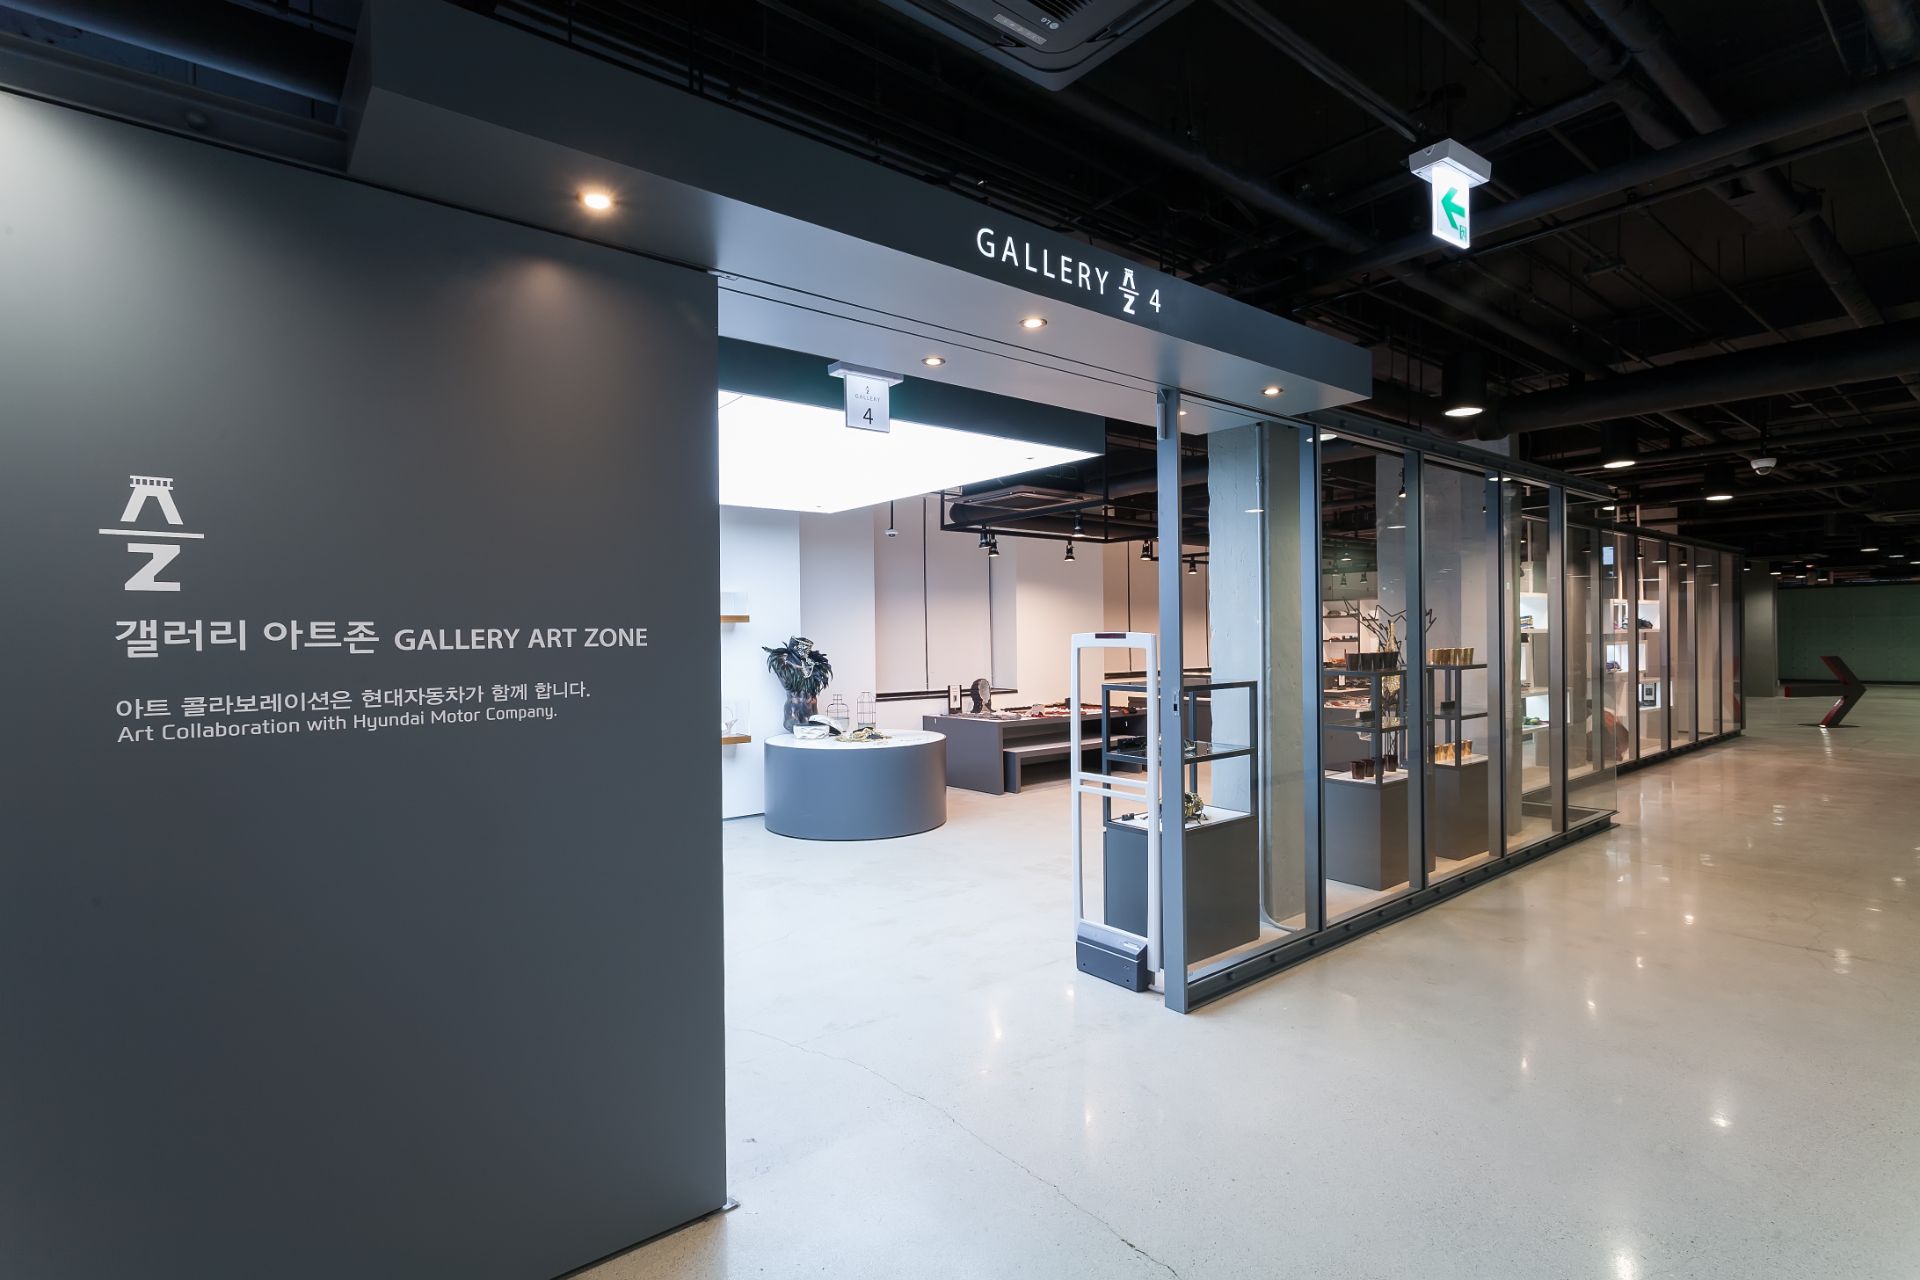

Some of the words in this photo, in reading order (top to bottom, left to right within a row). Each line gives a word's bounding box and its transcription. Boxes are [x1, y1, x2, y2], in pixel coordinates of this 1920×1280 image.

[976, 228, 1109, 295] GALLERY
[1149, 288, 1161, 313] 4
[863, 408, 874, 425] 4
[115, 619, 247, 659] 갤러리
[263, 619, 380, 654] 아트존
[394, 628, 520, 651] GALLERY
[527, 628, 578, 649] ART
[583, 627, 648, 648] ZONE
[116, 698, 171, 719] 아트
[181, 690, 353, 717] 콜라보레이션은
[361, 685, 485, 708] 현대자동차가
[491, 683, 528, 702] 함께
[534, 681, 591, 700] 합니다.
[117, 725, 154, 743] Art
[162, 719, 300, 741] Collaboration
[307, 715, 346, 732] with
[353, 711, 425, 732] Hyundai
[431, 709, 481, 725] Motor
[486, 706, 558, 722] Company.
